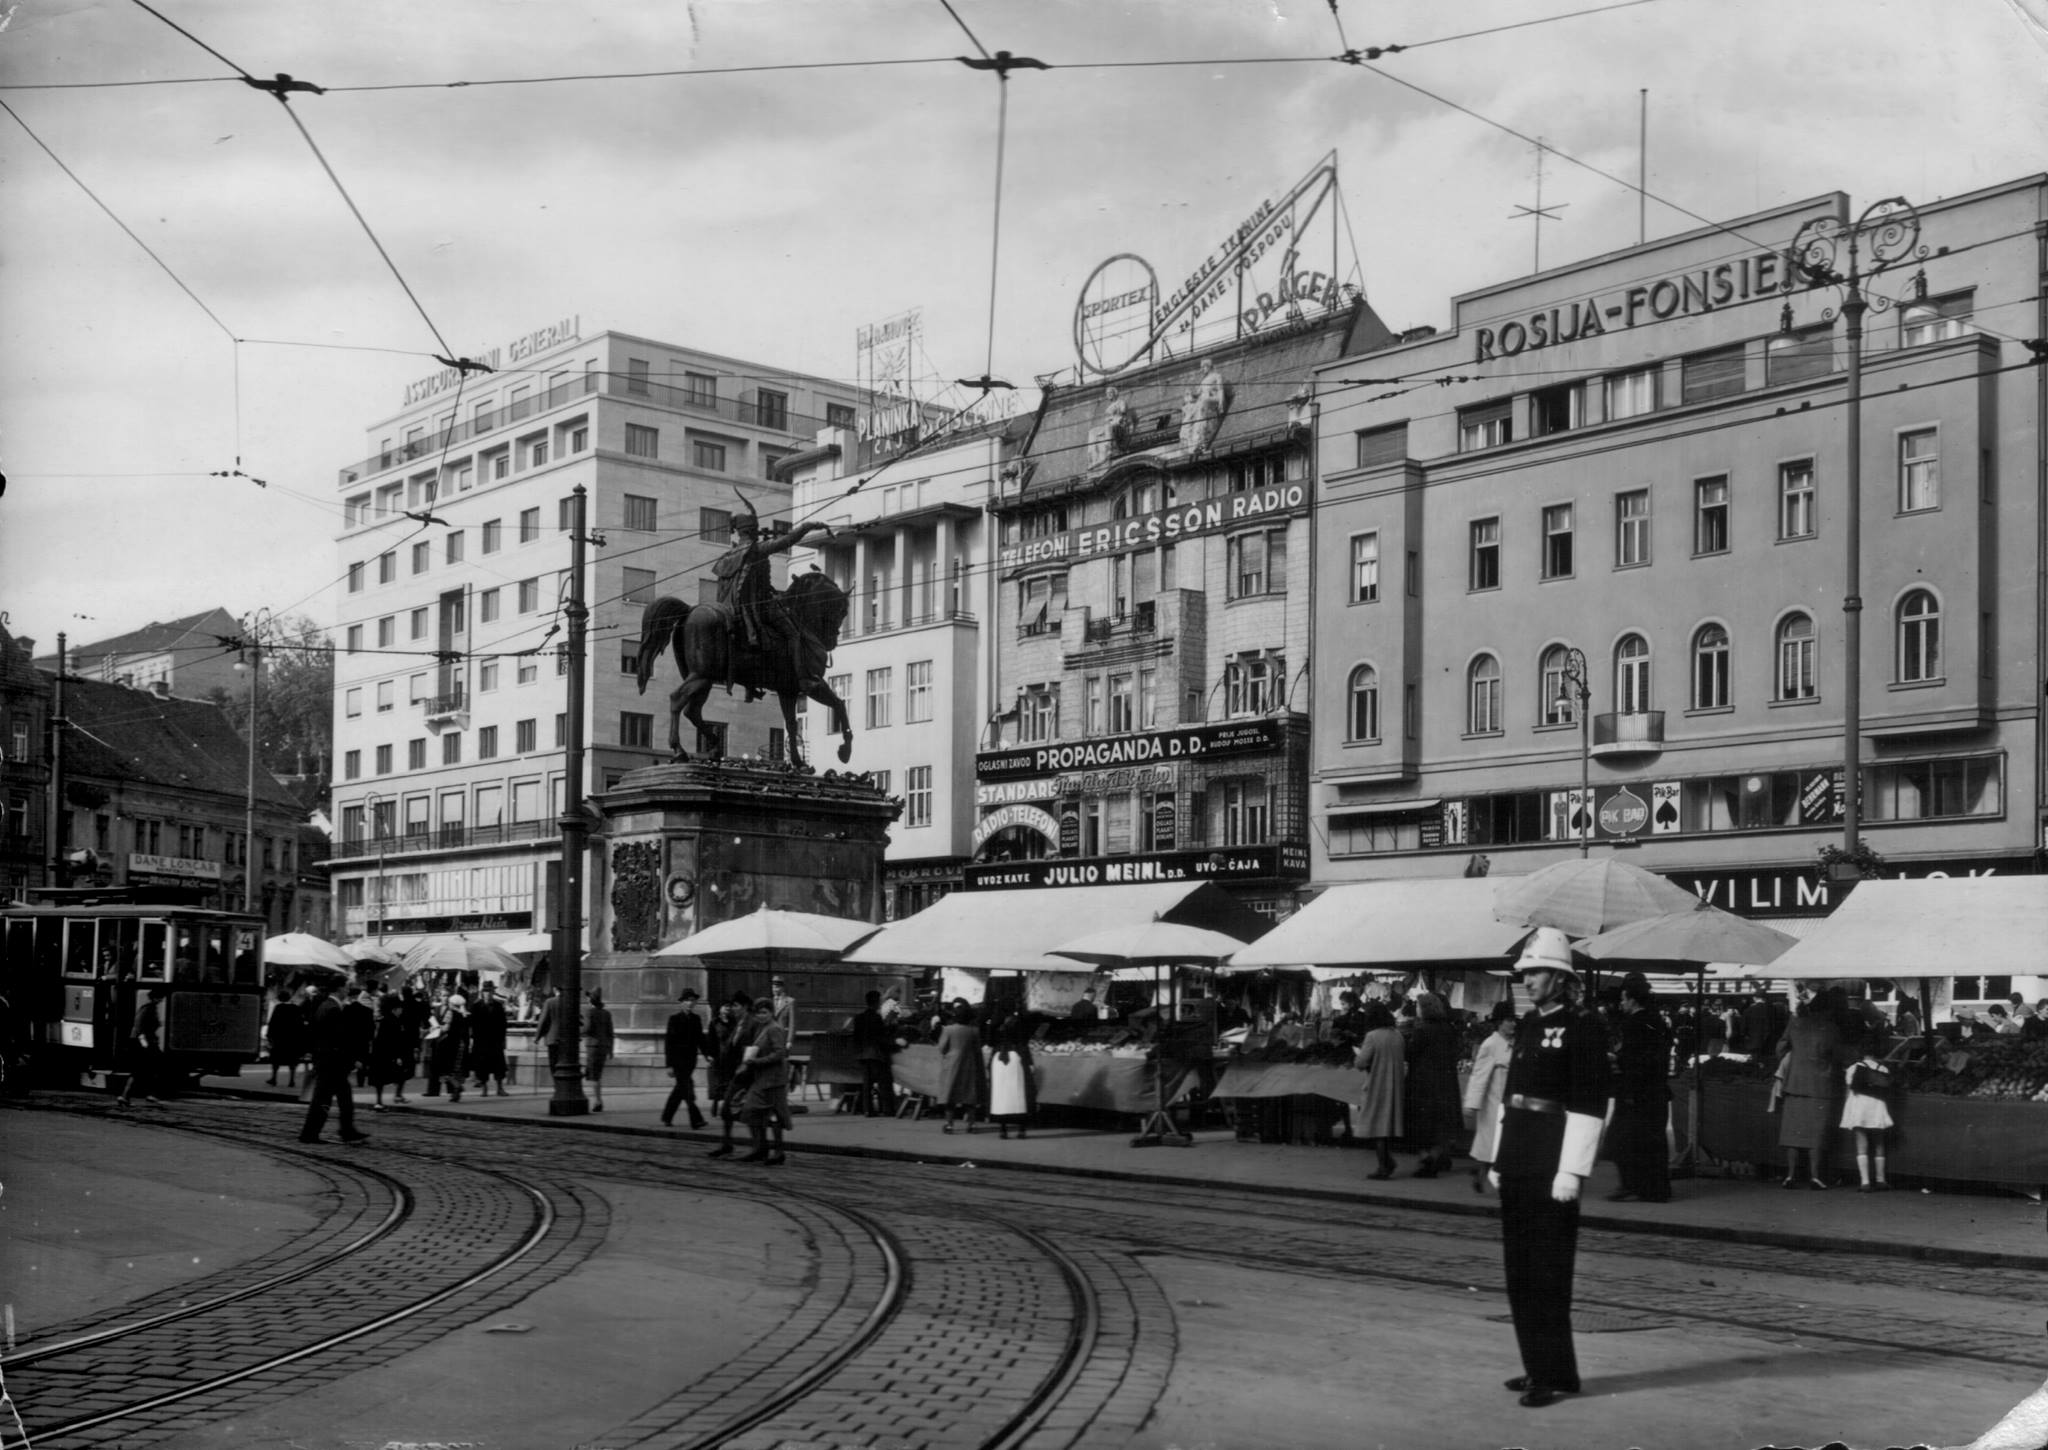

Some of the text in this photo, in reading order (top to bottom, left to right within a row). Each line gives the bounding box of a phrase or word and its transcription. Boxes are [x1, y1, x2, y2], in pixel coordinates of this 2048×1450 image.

[1083, 287, 1149, 319] SPORTEX
[510, 313, 579, 361] GENERALI
[858, 400, 919, 443] PLANINKA
[1001, 486, 1303, 568] TELEFONI ERICSSON RADIO
[978, 759, 1008, 771] OGLASNI
[1009, 756, 1031, 768] ZAVOD
[1037, 737, 1163, 770] PROPAGANDA
[1282, 847, 1307, 858] MEINL
[1283, 858, 1307, 869] KAVA
[977, 875, 1002, 886] UVOZ
[1004, 873, 1030, 884] KAVE
[1043, 865, 1099, 885] JULIO
[1105, 861, 1166, 882] MEINL
[1196, 861, 1226, 872] UVO
[1228, 858, 1260, 870] ČAJA
[1695, 875, 1828, 908] VILIM
